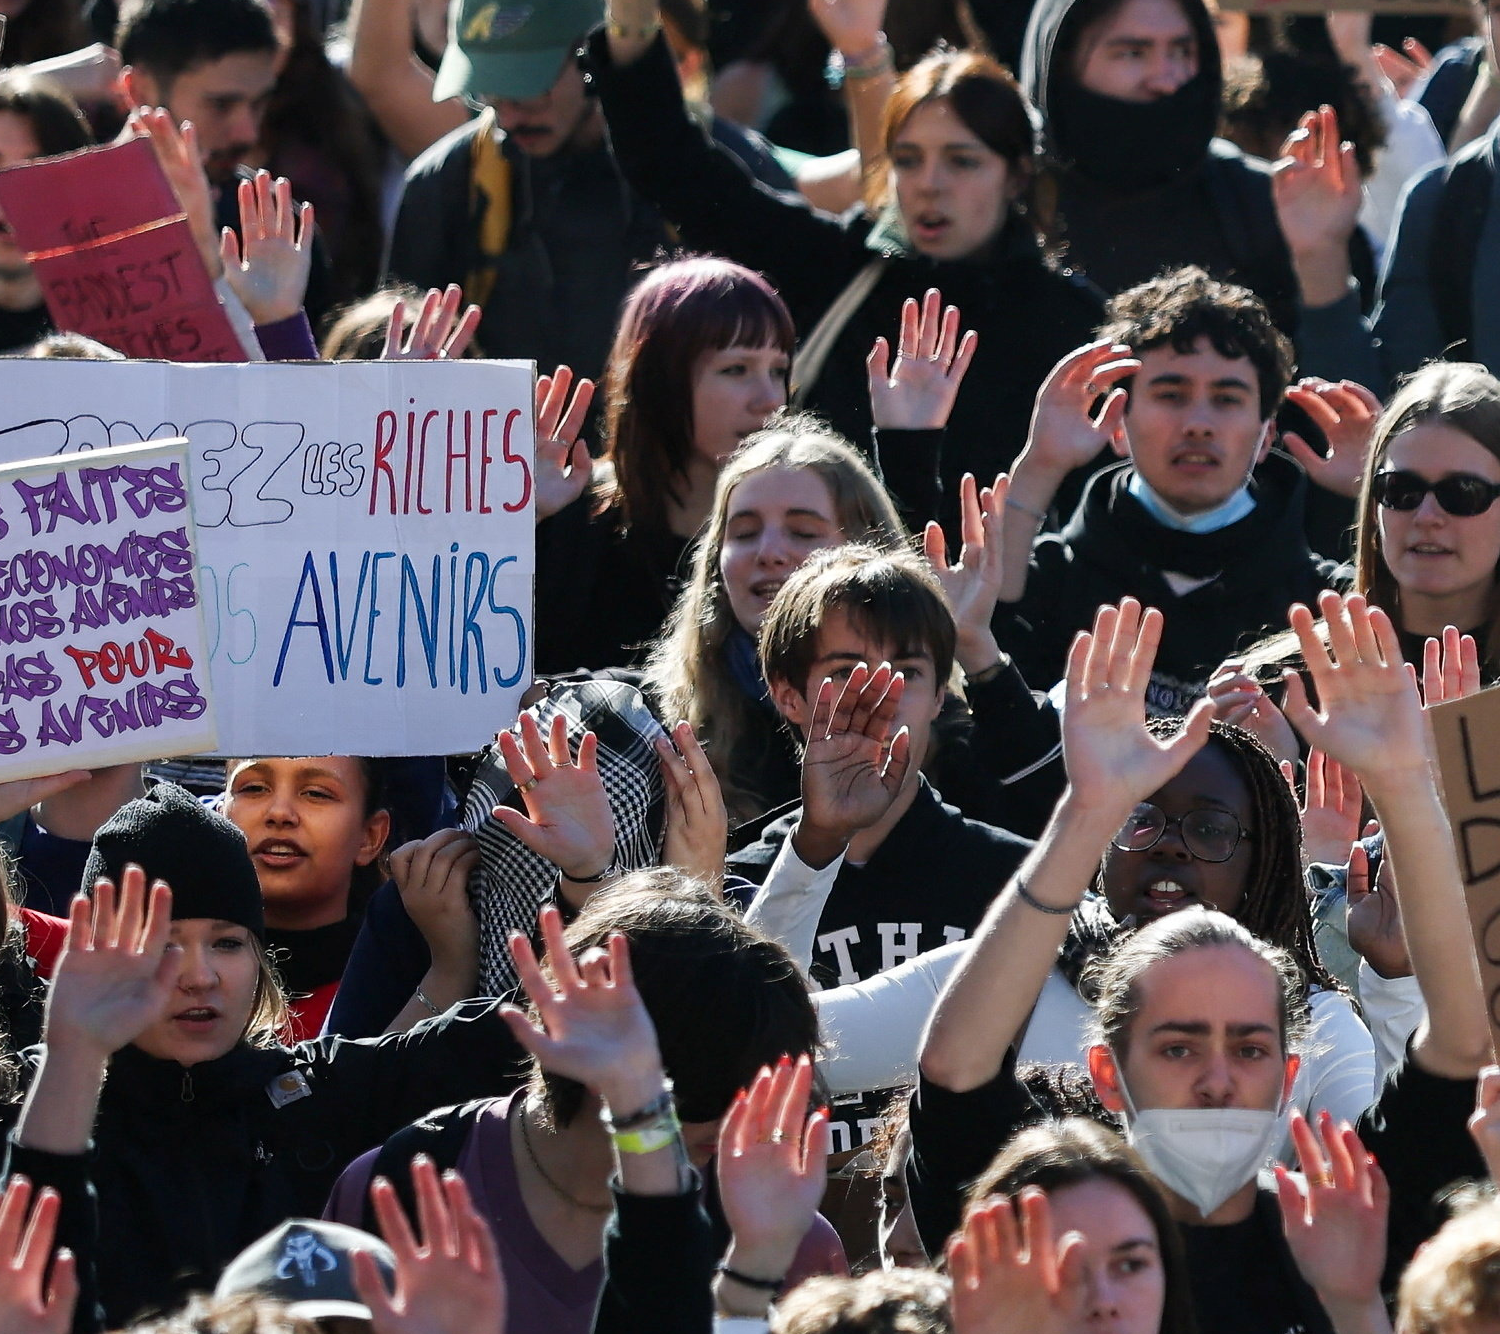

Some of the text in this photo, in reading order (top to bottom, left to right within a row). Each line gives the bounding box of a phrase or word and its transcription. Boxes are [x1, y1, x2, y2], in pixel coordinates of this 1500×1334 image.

[12, 462, 190, 537] FAITES
[301, 440, 366, 499] LES
[63, 626, 194, 690] POUR
